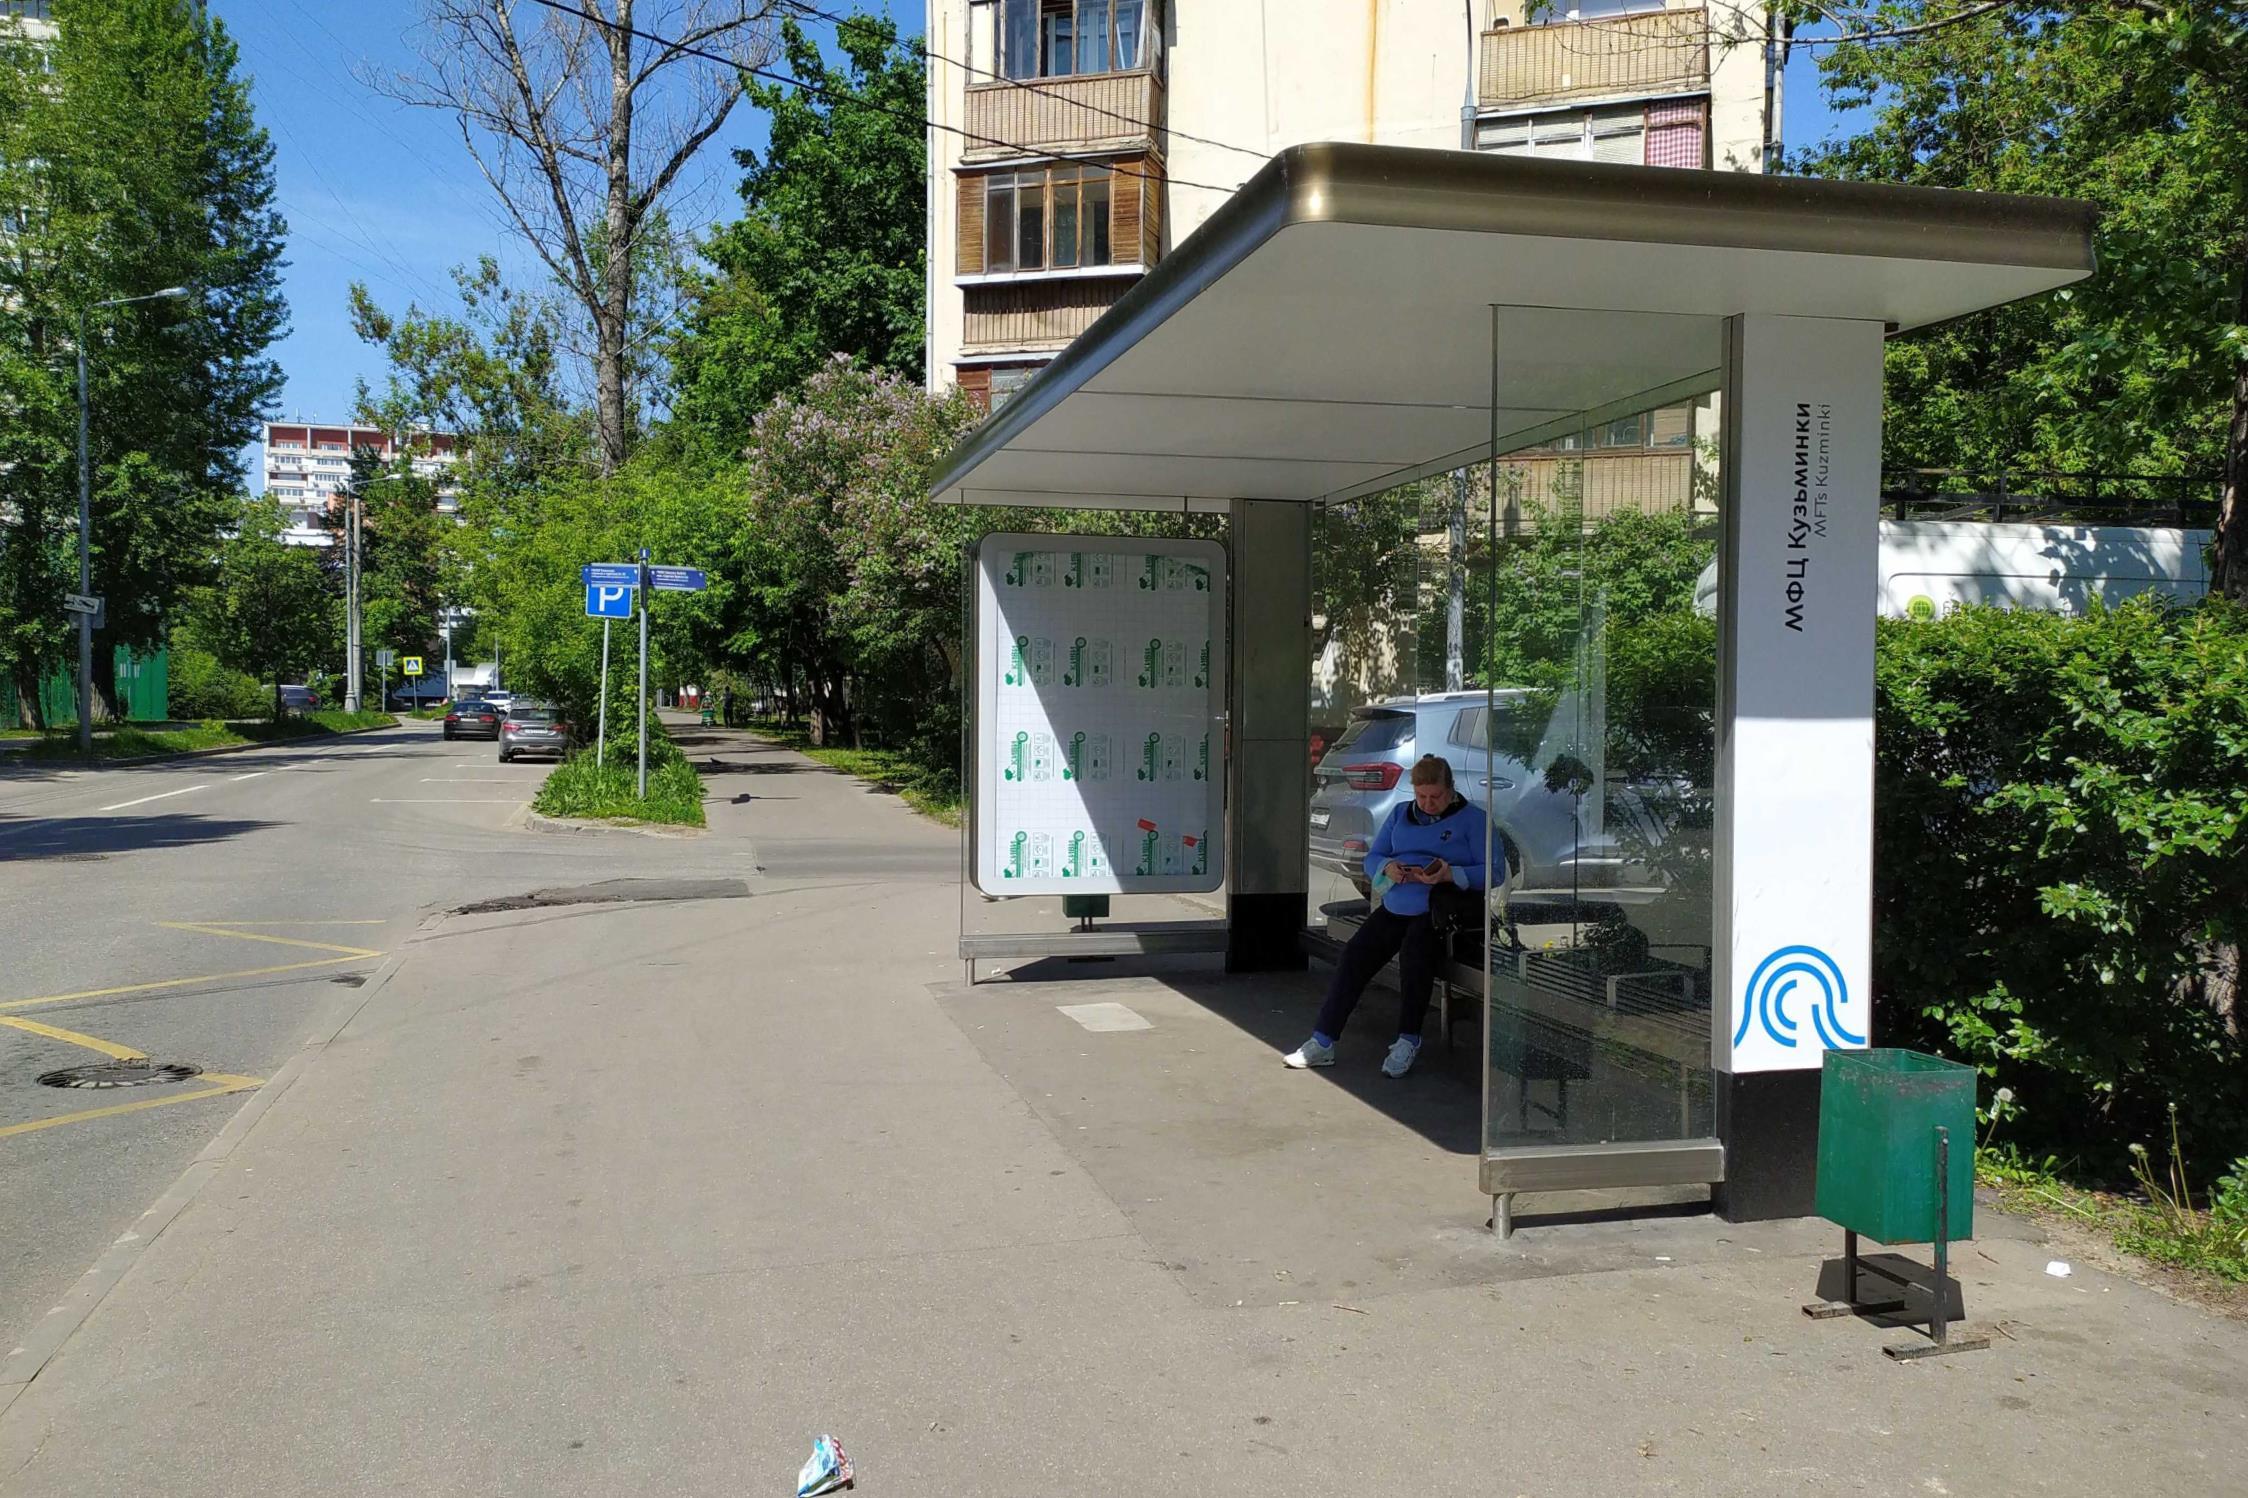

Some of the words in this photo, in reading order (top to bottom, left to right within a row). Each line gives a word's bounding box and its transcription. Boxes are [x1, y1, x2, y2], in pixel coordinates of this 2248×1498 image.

[1787, 403, 1811, 549] Кузьминки
[1815, 403, 1831, 487] Kuzminki
[1814, 492, 1828, 538] MFTs
[598, 587, 624, 612] P
[1784, 558, 1809, 632] МФЦ
